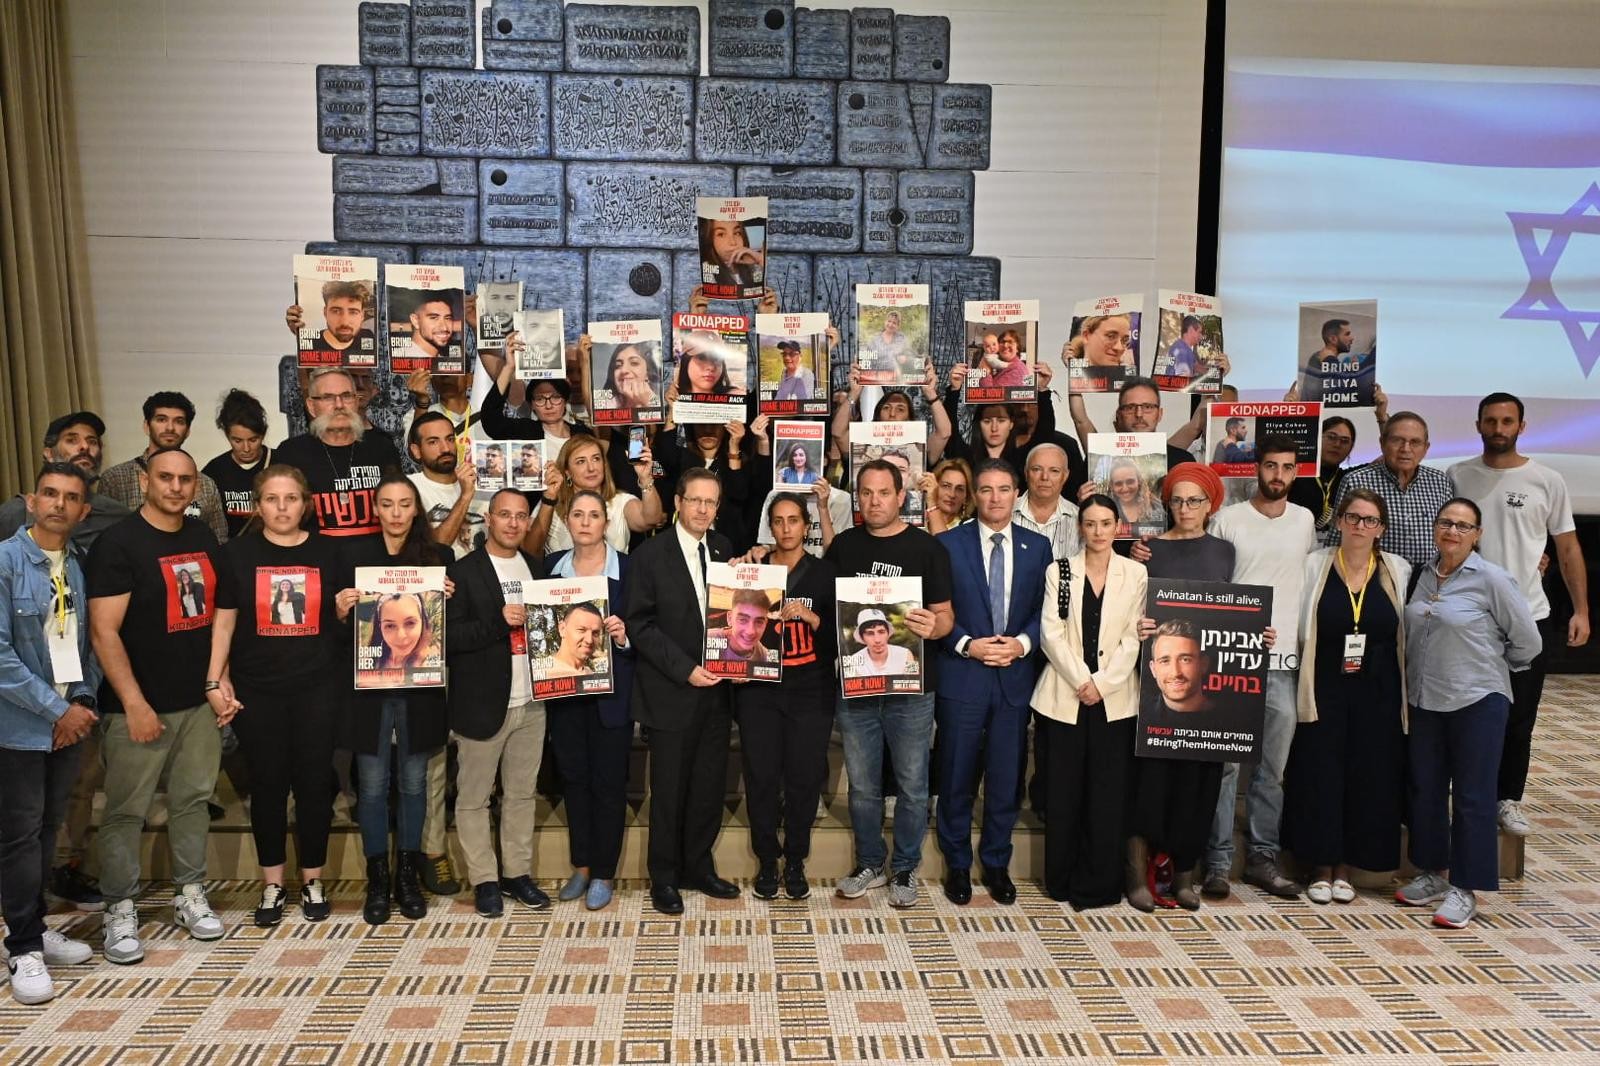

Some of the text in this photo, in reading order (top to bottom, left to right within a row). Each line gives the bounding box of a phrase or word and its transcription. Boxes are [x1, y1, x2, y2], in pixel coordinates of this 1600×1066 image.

[679, 315, 744, 329] KIDNAPPED
[299, 329, 320, 339] BRING
[300, 340, 313, 350] HIM
[391, 337, 411, 347] BRING
[300, 352, 320, 362] HOME
[321, 351, 342, 362] NOW!
[393, 360, 412, 370] HOME
[413, 359, 432, 370] NOW!
[1321, 362, 1360, 373] BRING
[967, 369, 986, 377] BRING
[760, 381, 779, 390] BRING
[967, 379, 979, 387] HER
[1323, 379, 1358, 388] ELIYA
[968, 389, 987, 399] HOME
[1323, 393, 1358, 403] HOME
[1230, 405, 1306, 415] KIDNAPPED
[350, 466, 380, 478] מחזירים
[1156, 589, 1262, 606] Avinatan is still alive.
[259, 626, 317, 635] KIDNAPPED
[707, 637, 728, 649] BRING
[1200, 629, 1263, 651] אבינתן
[359, 645, 382, 657] BRING
[706, 649, 719, 659] HIM
[359, 658, 374, 669] HER
[706, 661, 725, 672] HOME
[726, 661, 747, 672] NOW!
[1217, 651, 1263, 673] עדיין
[534, 676, 575, 693] HOME NOW!
[844, 677, 886, 690] HOME NOW!
[1203, 674, 1261, 694] בחיים.
[1173, 728, 1199, 737] הביתה
[1201, 730, 1222, 739] אותם
[1223, 732, 1254, 741] מחזירים
[1147, 737, 1253, 752] #BringThemHomeNow
